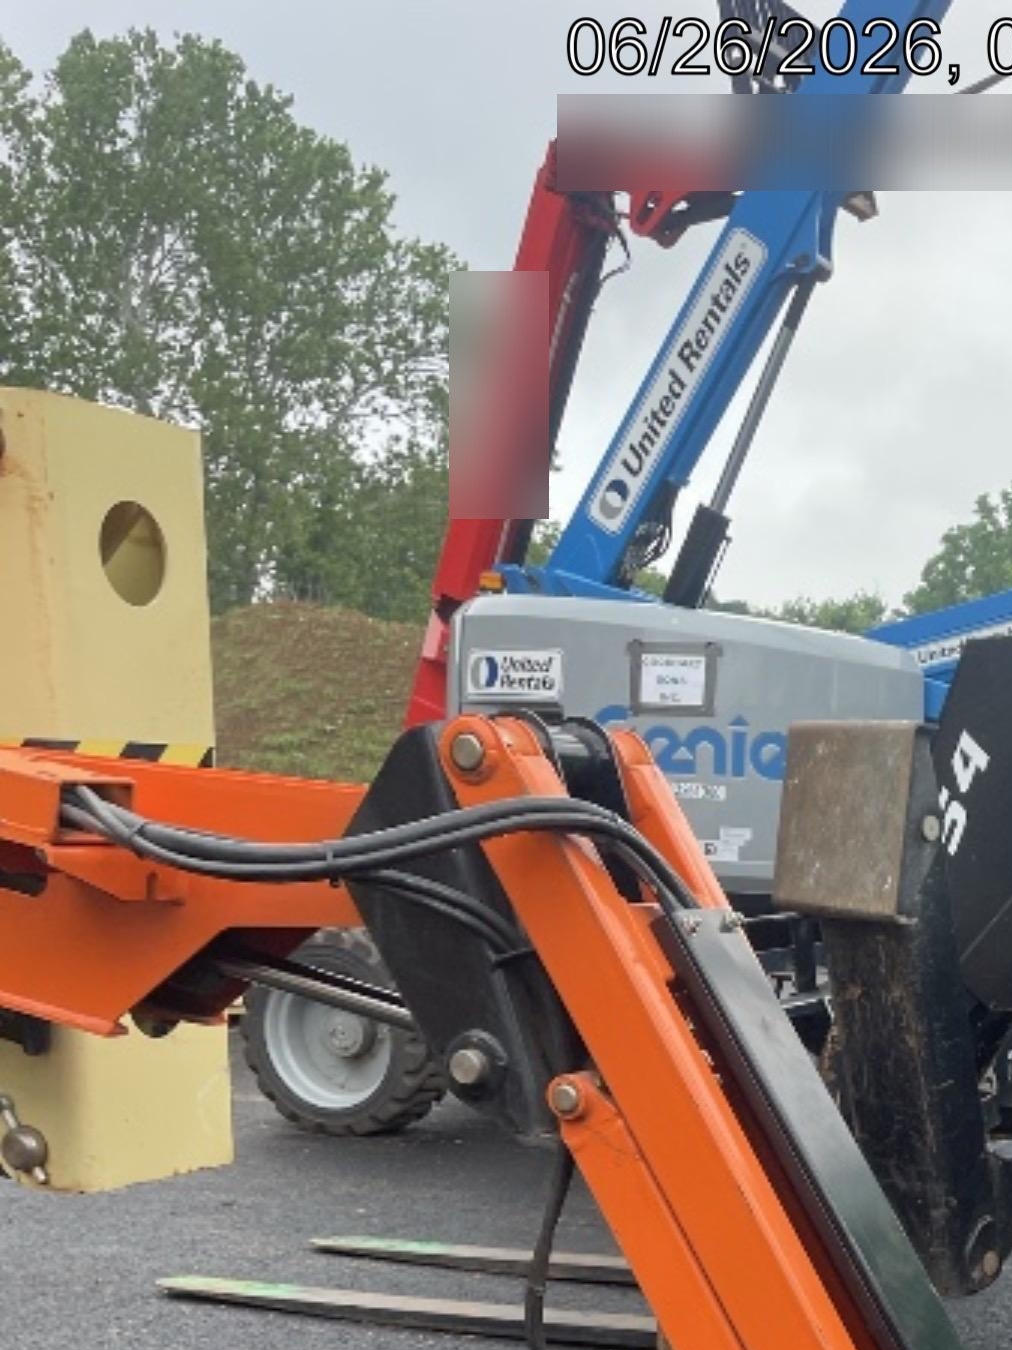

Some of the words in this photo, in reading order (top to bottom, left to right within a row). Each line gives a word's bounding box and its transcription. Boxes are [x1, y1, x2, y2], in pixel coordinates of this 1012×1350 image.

[621, 369, 688, 478] United
[677, 250, 751, 373] Rentals
[501, 655, 552, 672] United
